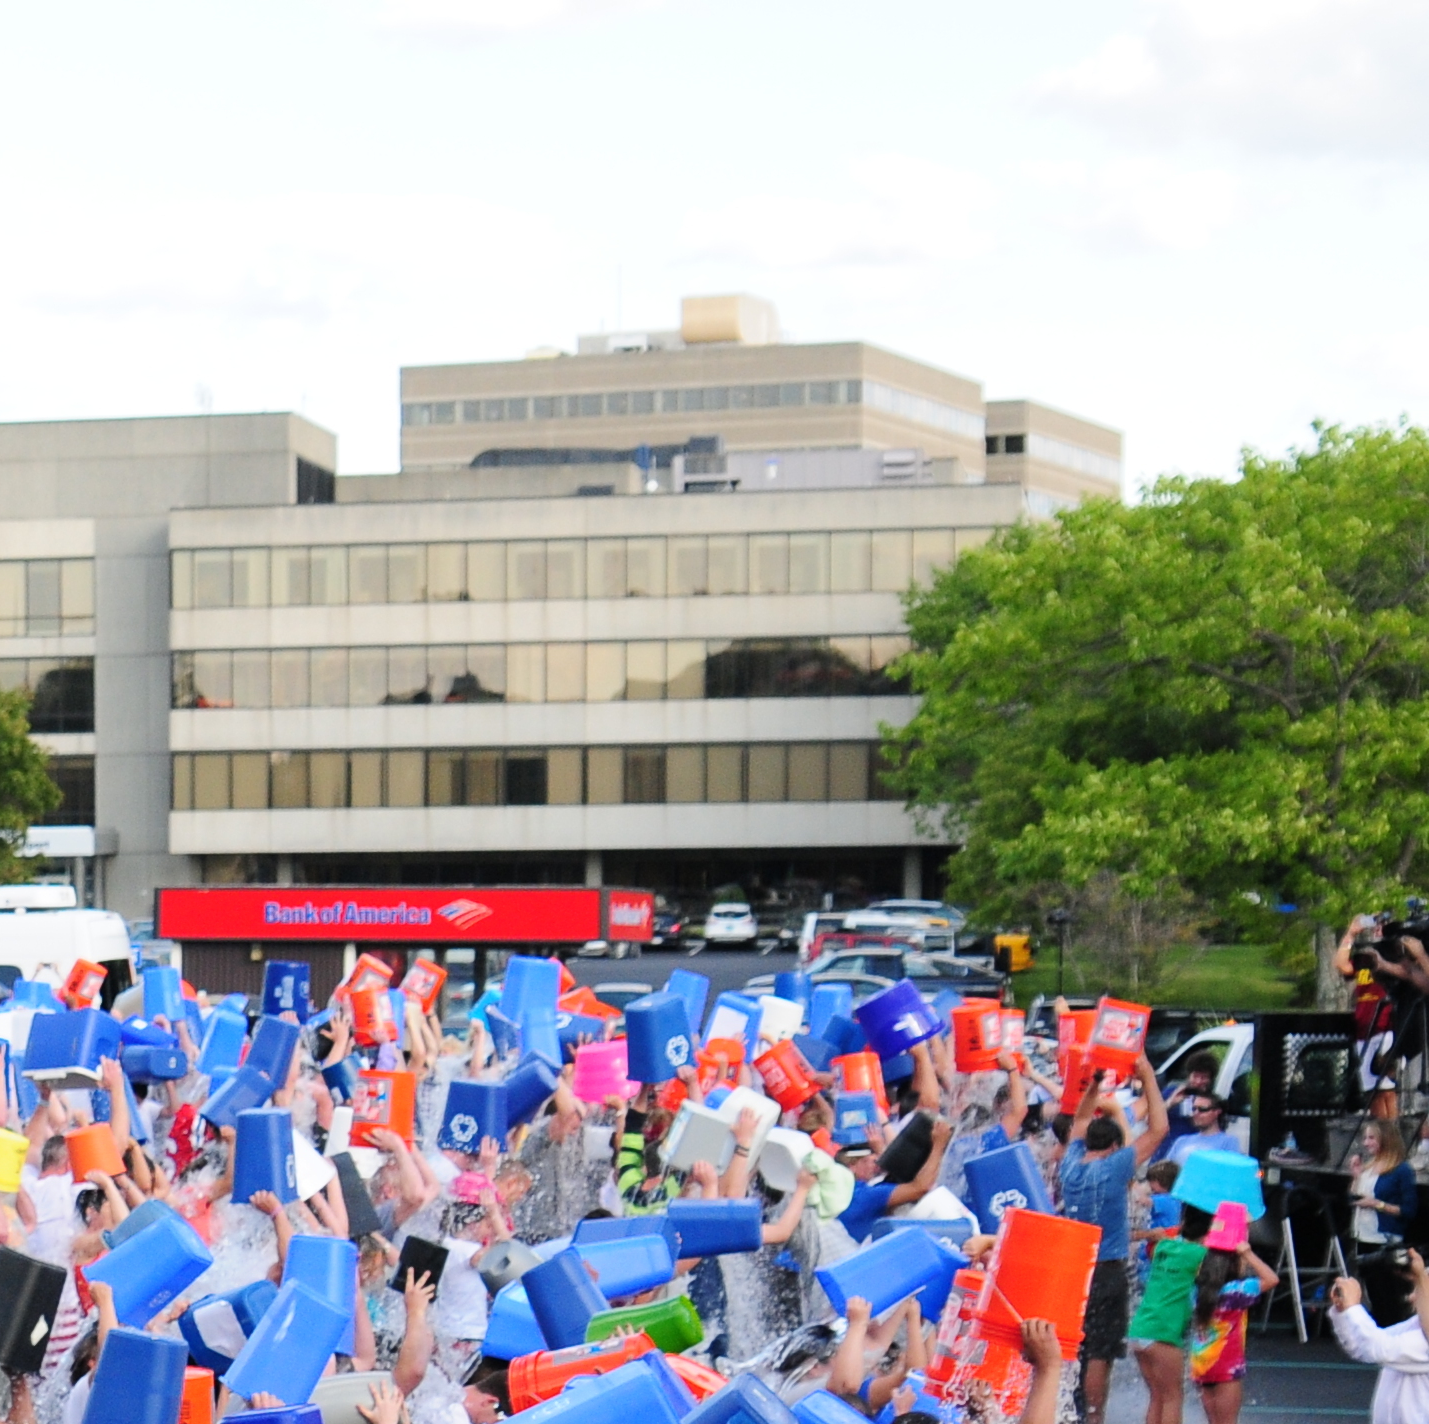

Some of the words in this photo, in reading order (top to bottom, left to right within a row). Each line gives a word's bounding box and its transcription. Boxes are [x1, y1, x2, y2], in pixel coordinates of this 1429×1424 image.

[264, 901, 319, 923] Bank
[320, 901, 343, 923] of
[344, 901, 431, 924] America
